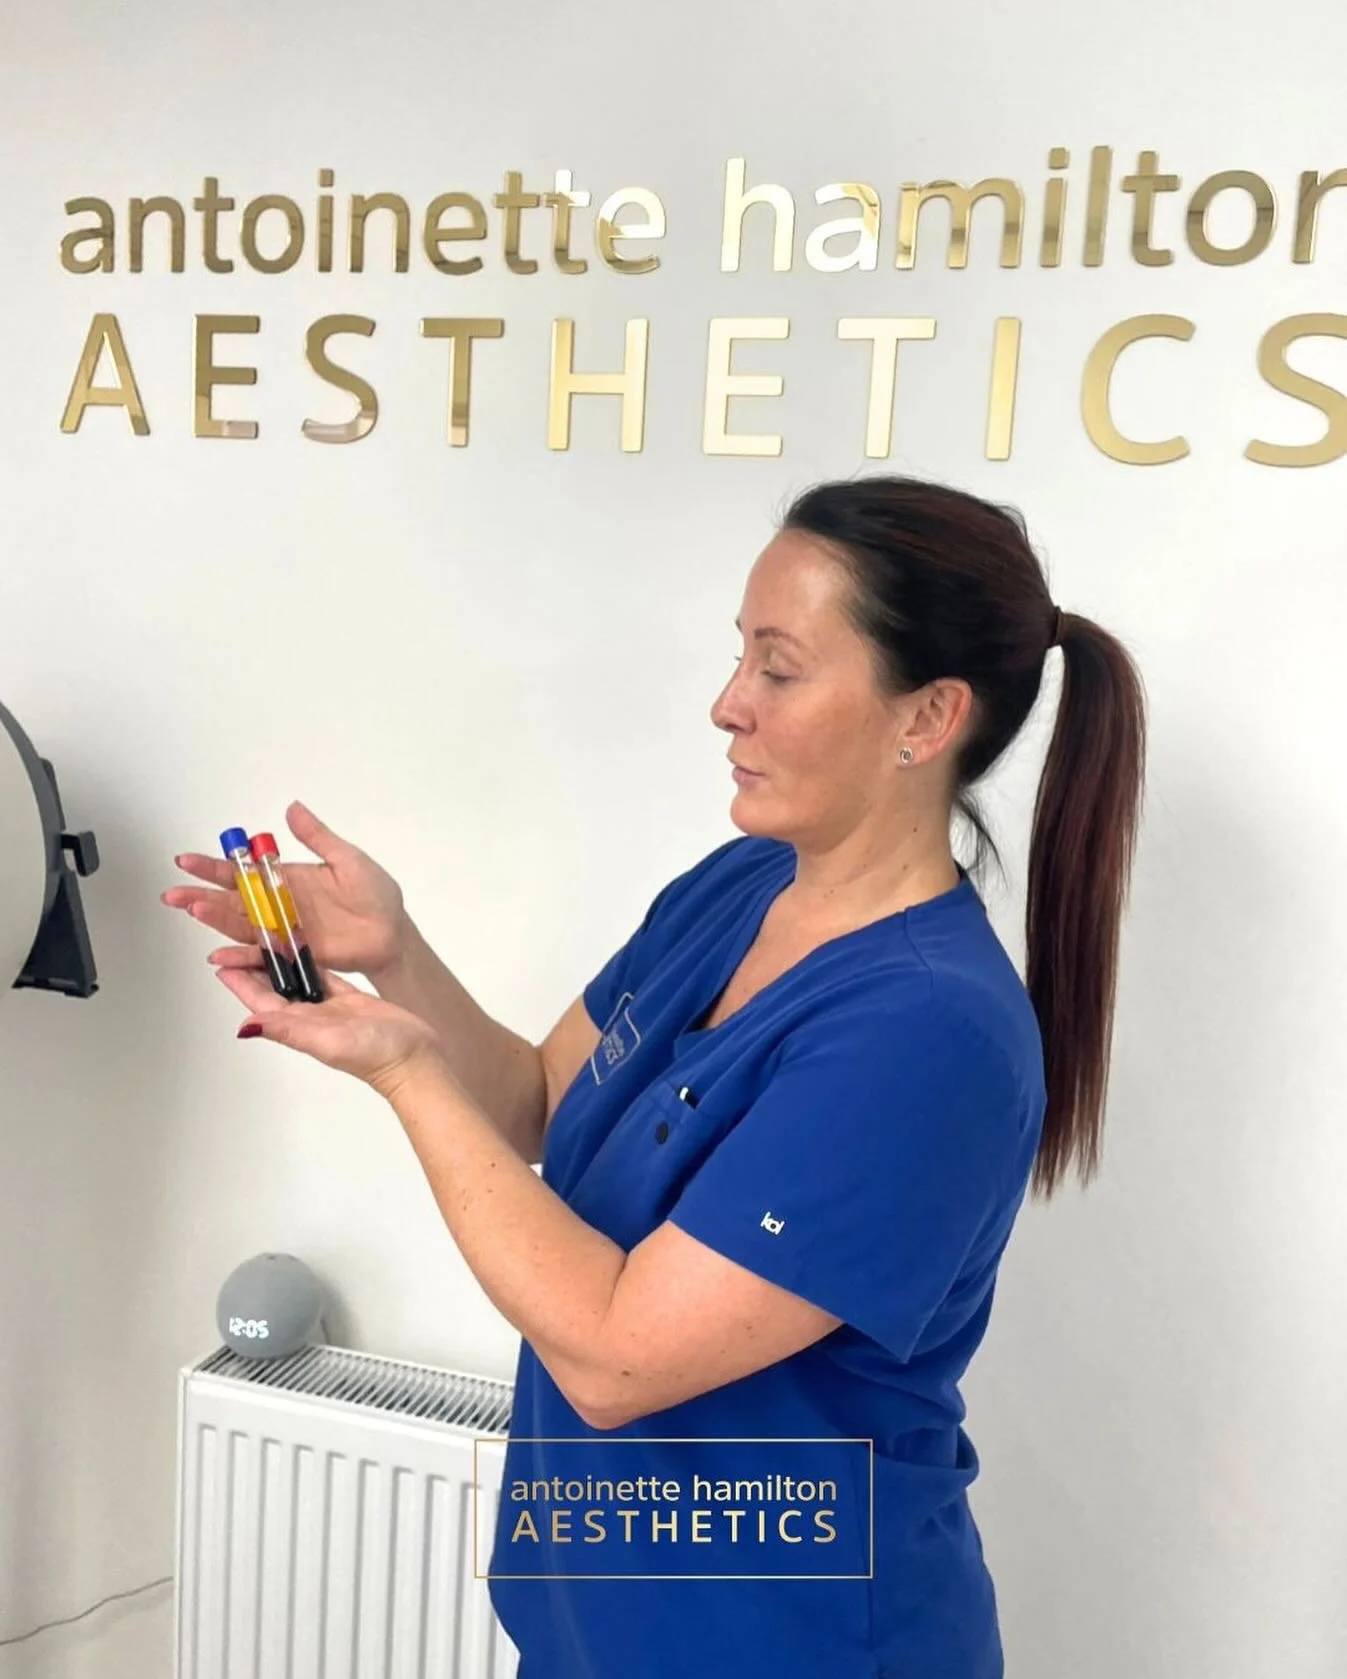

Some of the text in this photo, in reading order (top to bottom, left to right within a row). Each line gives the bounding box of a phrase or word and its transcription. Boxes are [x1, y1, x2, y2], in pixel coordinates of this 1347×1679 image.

[58, 167, 668, 276] antoinette
[59, 311, 1347, 469] AESTHETICS
[229, 1317, 269, 1339] 12:05
